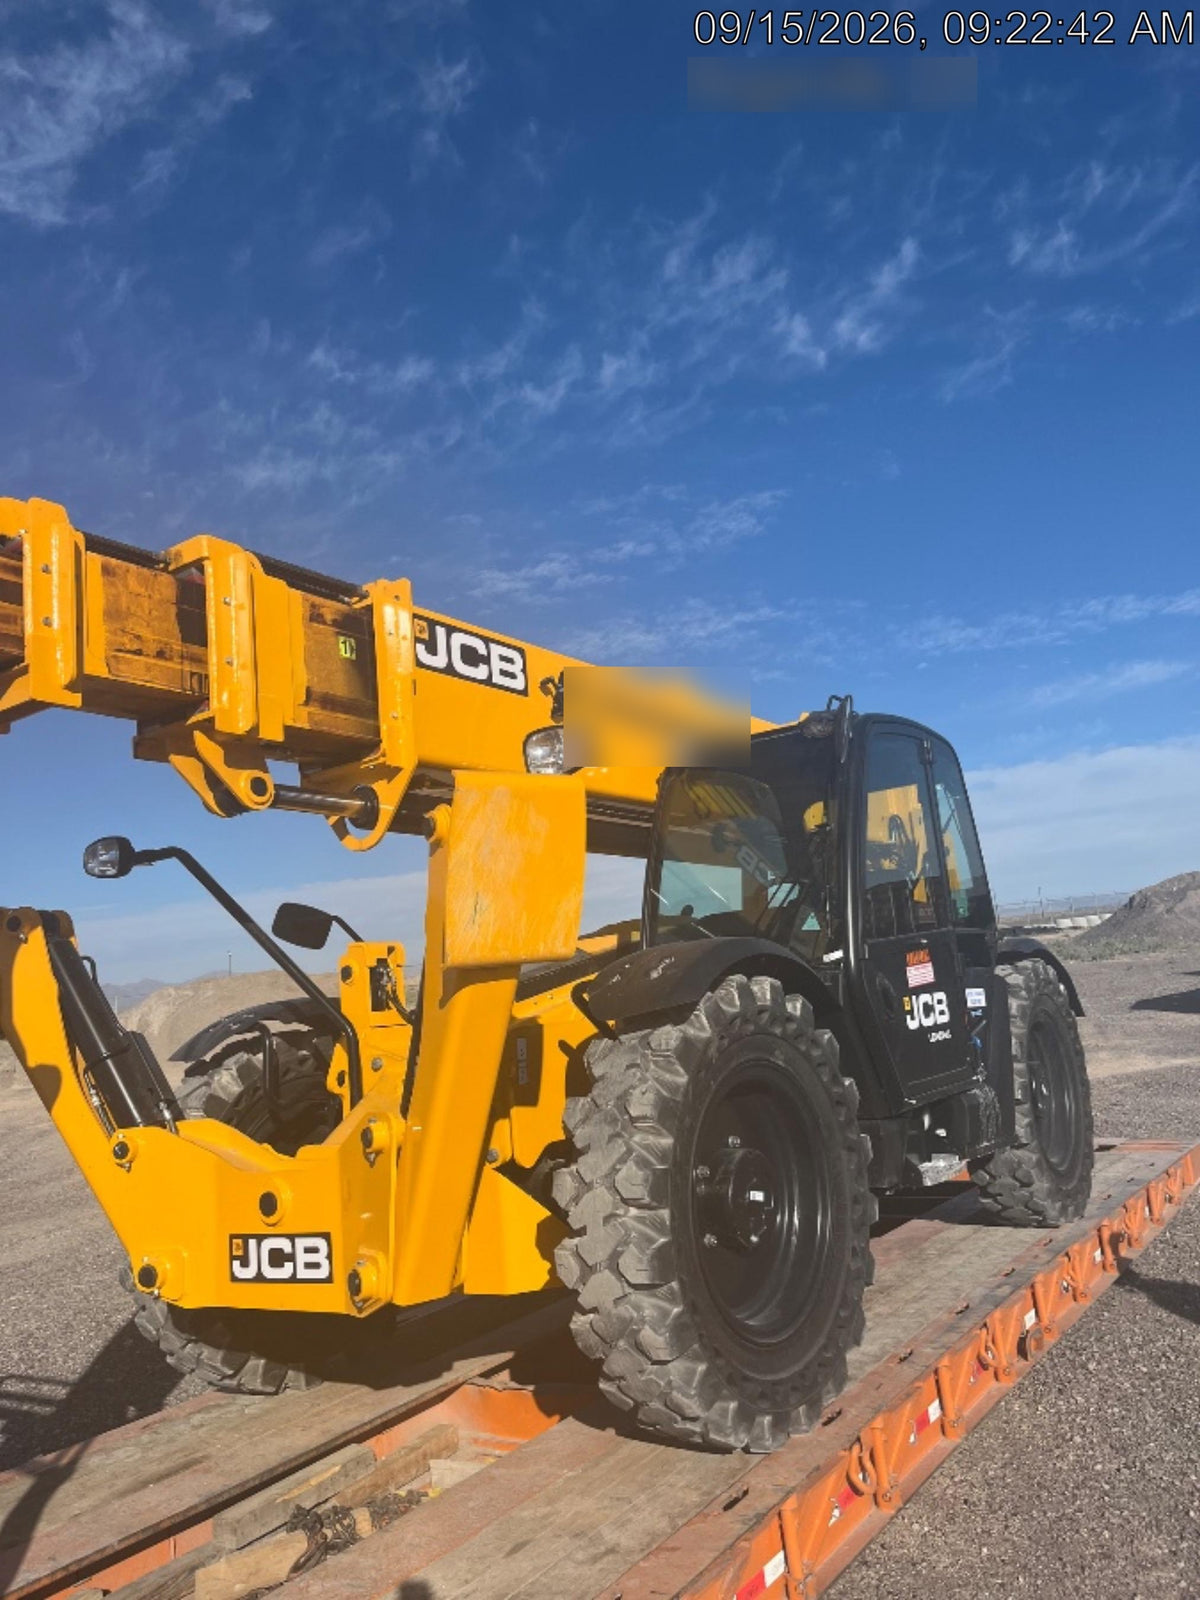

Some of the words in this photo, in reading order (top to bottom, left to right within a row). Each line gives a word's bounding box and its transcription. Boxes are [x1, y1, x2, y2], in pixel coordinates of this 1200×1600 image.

[416, 625, 526, 691] JCB
[906, 991, 950, 1030] JCB
[232, 1237, 330, 1279] JCB
